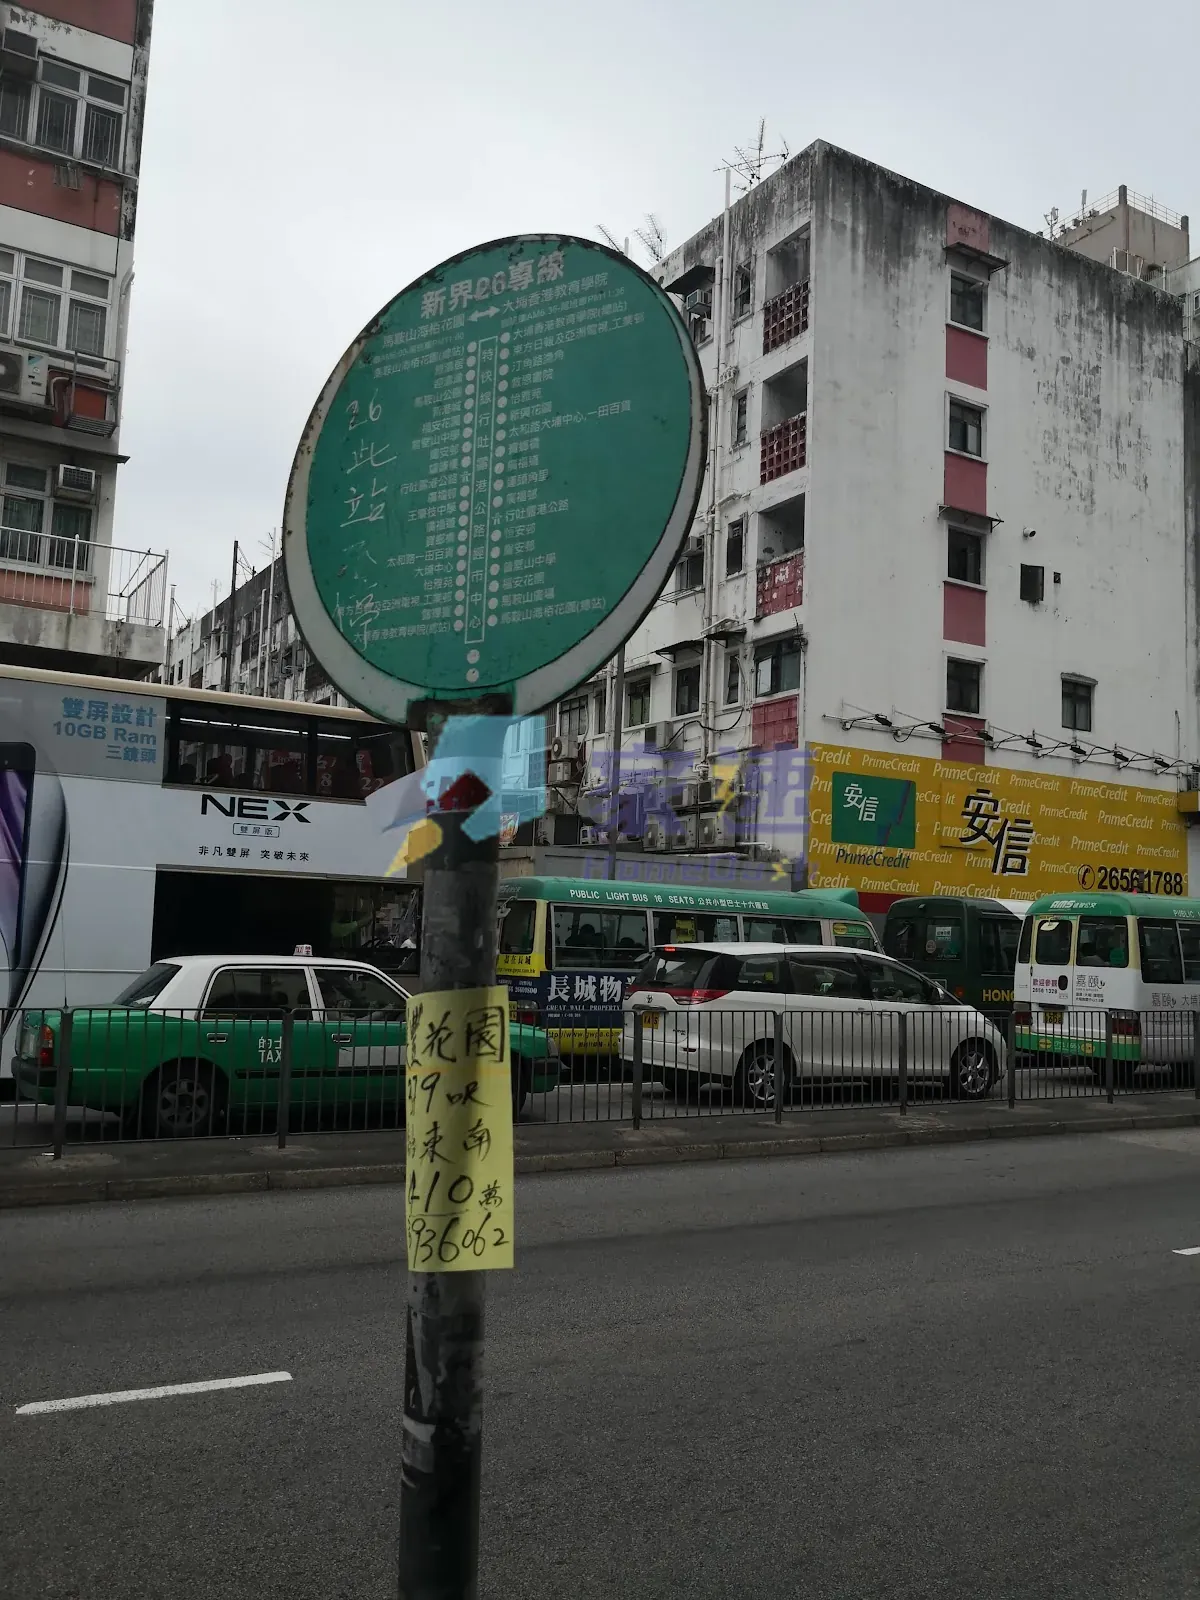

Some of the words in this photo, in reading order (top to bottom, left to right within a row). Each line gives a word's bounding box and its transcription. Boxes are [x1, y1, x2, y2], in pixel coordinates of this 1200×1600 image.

[502, 272, 609, 314] 大埔香港教育學院
[62, 697, 158, 727] 雙屏設計
[52, 720, 108, 740] 10GB
[113, 727, 157, 745] Ram
[105, 744, 157, 764] 三鏡頭
[810, 747, 852, 766] Credit
[861, 754, 921, 774] PrimeCredit
[933, 763, 1001, 785] PrimeCredit
[1010, 774, 1060, 792] PrimeCredit
[1070, 781, 1128, 802] PrimeCredit
[201, 793, 312, 824] NEX
[843, 783, 880, 822] 安信
[1040, 805, 1088, 821] PrimeCredit
[1098, 810, 1155, 830] PrimeCredit
[240, 825, 274, 837] 雙屏版
[959, 788, 1035, 876] 安信
[199, 846, 250, 859] 非凡雙屏
[260, 849, 310, 862] 突破未來
[836, 848, 911, 869] PrimeCredit
[1071, 836, 1129, 855] PrimeCredit
[1136, 844, 1181, 859] PrimeCredit
[570, 889, 600, 900] PUBLIC
[606, 891, 630, 901] LIGHT
[632, 893, 649, 903] BUS
[655, 894, 663, 903] 16
[668, 896, 695, 906] SEATS
[861, 877, 920, 893] PrimeCredit
[933, 881, 1001, 898] PrimeCredit
[1050, 900, 1075, 909] AMS
[1173, 908, 1195, 919] PUBLIC
[407, 1003, 505, 1067] 花園
[258, 1049, 282, 1063] TAX
